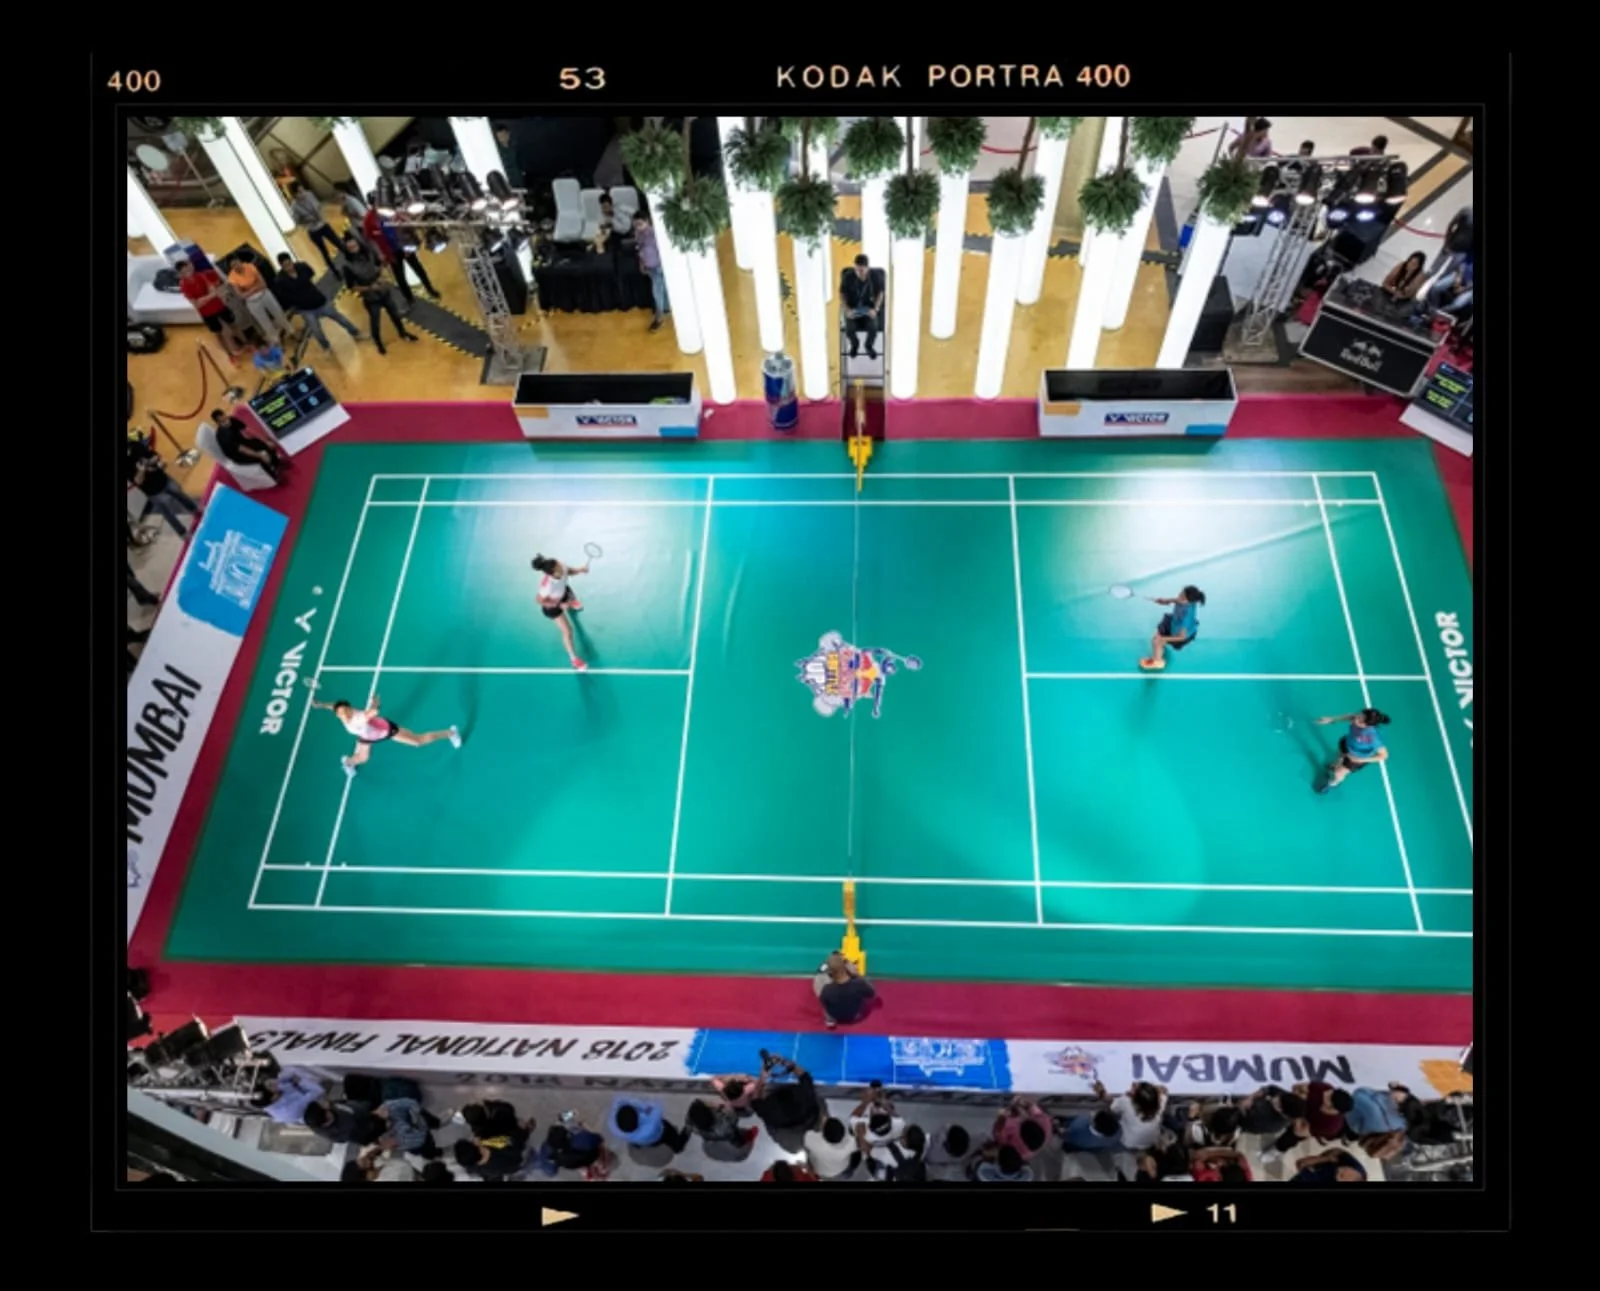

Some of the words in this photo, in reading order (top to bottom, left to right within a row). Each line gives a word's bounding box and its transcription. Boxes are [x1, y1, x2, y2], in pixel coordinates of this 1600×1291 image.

[1434, 611, 1473, 710] VICTOR
[260, 641, 308, 736] VICTOR
[127, 663, 203, 844] MUMBAI
[249, 1028, 380, 1054] FINALS
[383, 1033, 580, 1059] NATIONAL
[581, 1038, 680, 1062] 2018
[1130, 1052, 1356, 1084] MUMBAI
